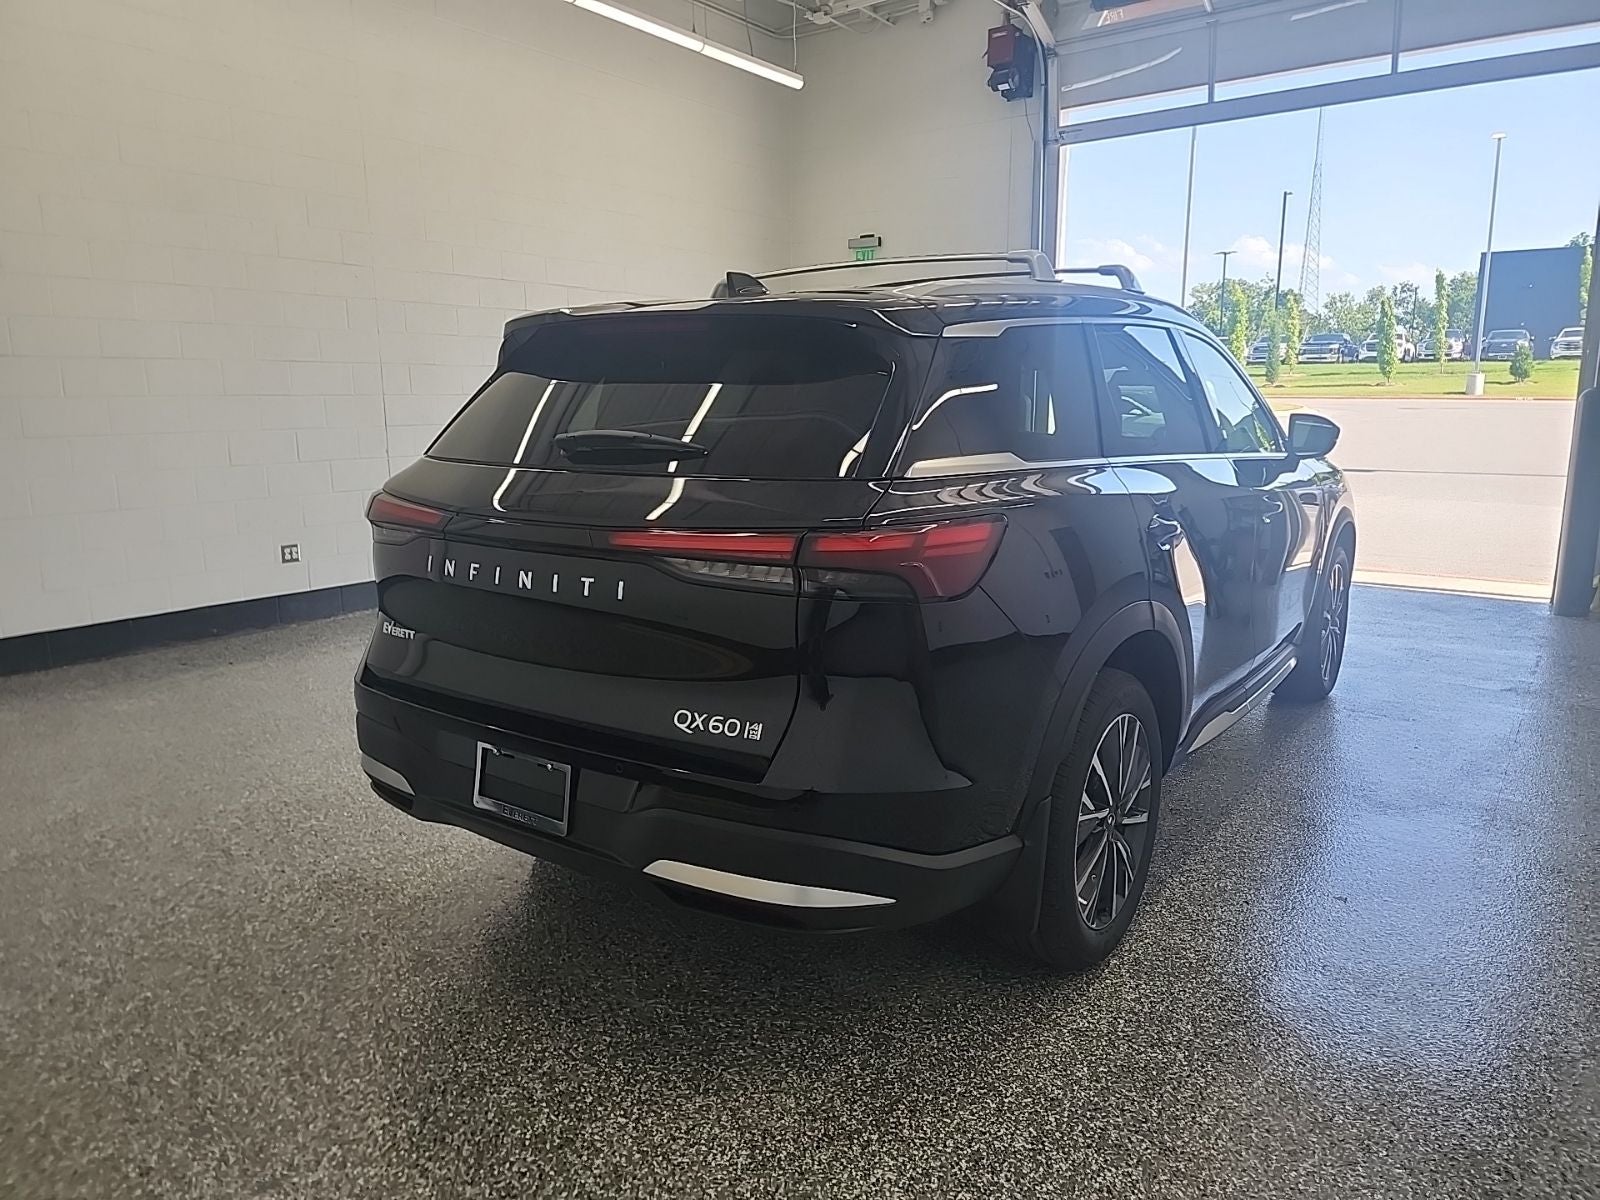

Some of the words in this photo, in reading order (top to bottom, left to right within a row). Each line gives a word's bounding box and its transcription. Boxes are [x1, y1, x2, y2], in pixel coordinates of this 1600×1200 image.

[855, 249, 876, 261] EXIT
[427, 555, 625, 601] INFINITI
[382, 620, 416, 640] EVERETT
[673, 709, 741, 737] QX60
